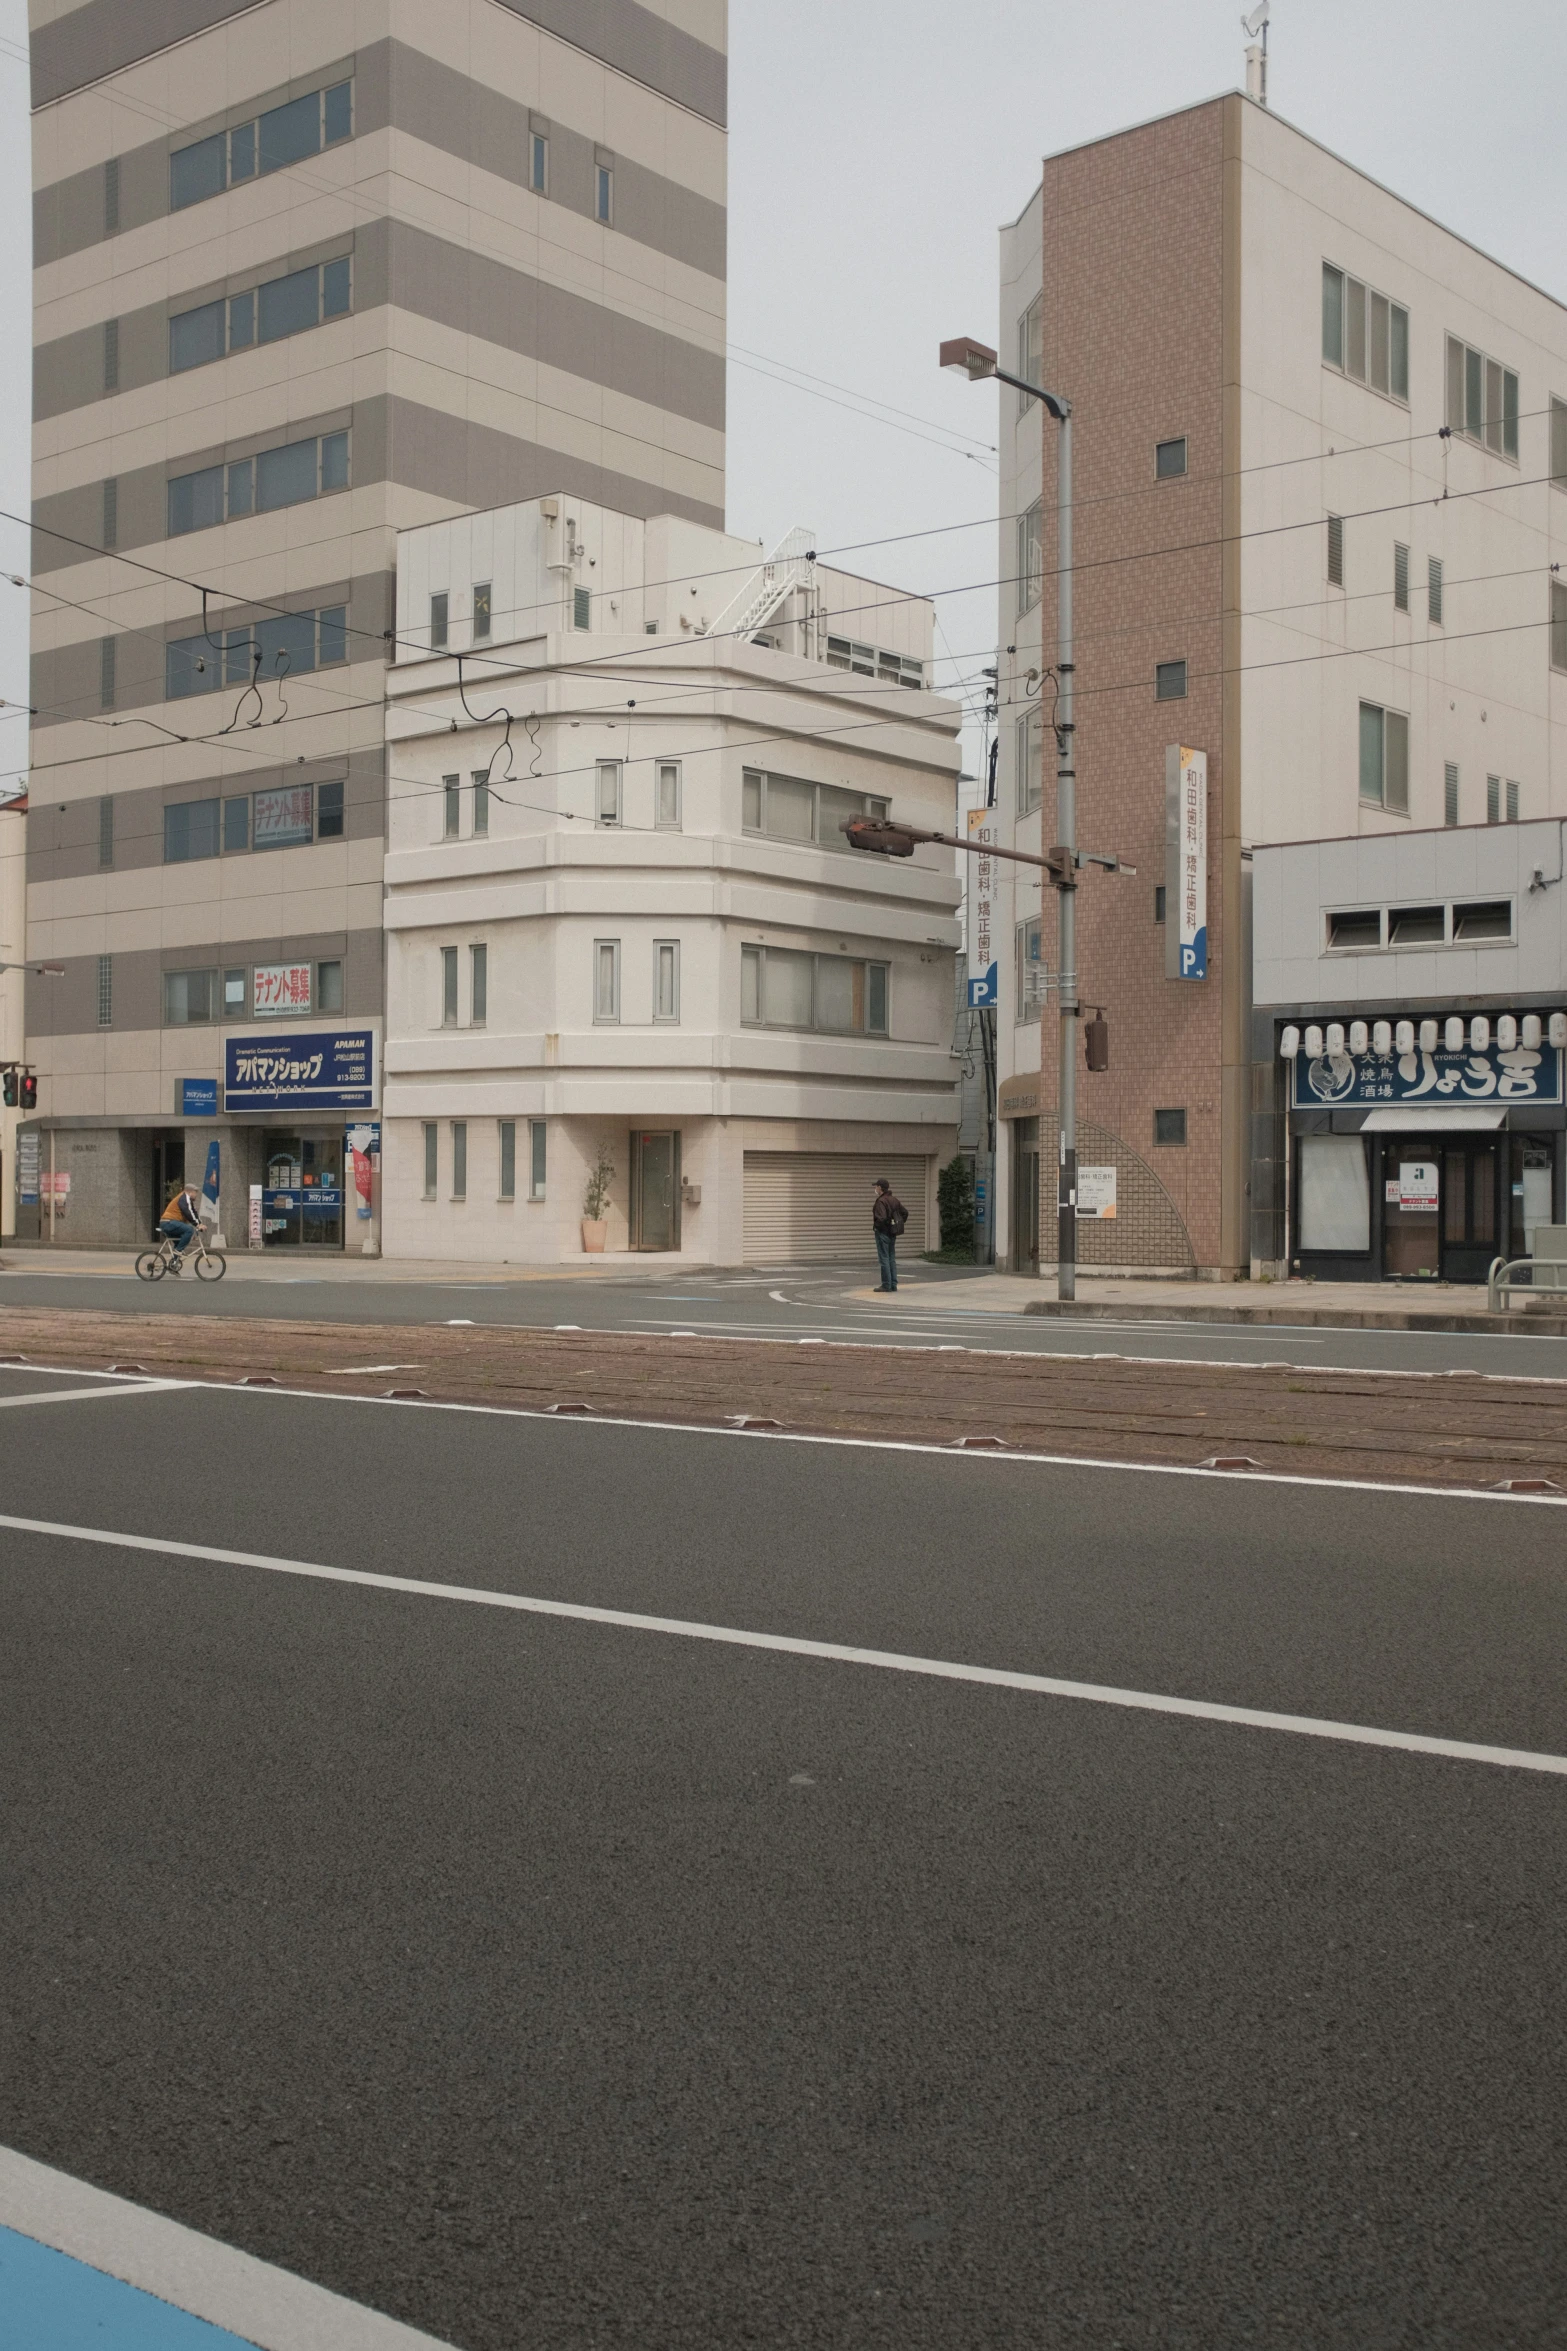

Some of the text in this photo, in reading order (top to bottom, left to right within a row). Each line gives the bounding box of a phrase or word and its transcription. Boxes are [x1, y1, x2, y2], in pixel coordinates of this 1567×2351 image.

[1183, 949, 1196, 975] P
[256, 968, 310, 1004] テナント募集
[973, 982, 989, 1005] P
[334, 1039, 366, 1049] APAMAN
[235, 1053, 323, 1082] アパマンショップ
[1360, 1068, 1394, 1081] 焼鳥
[1398, 1045, 1543, 1098] りょう吉
[1360, 1084, 1394, 1097] 酒場
